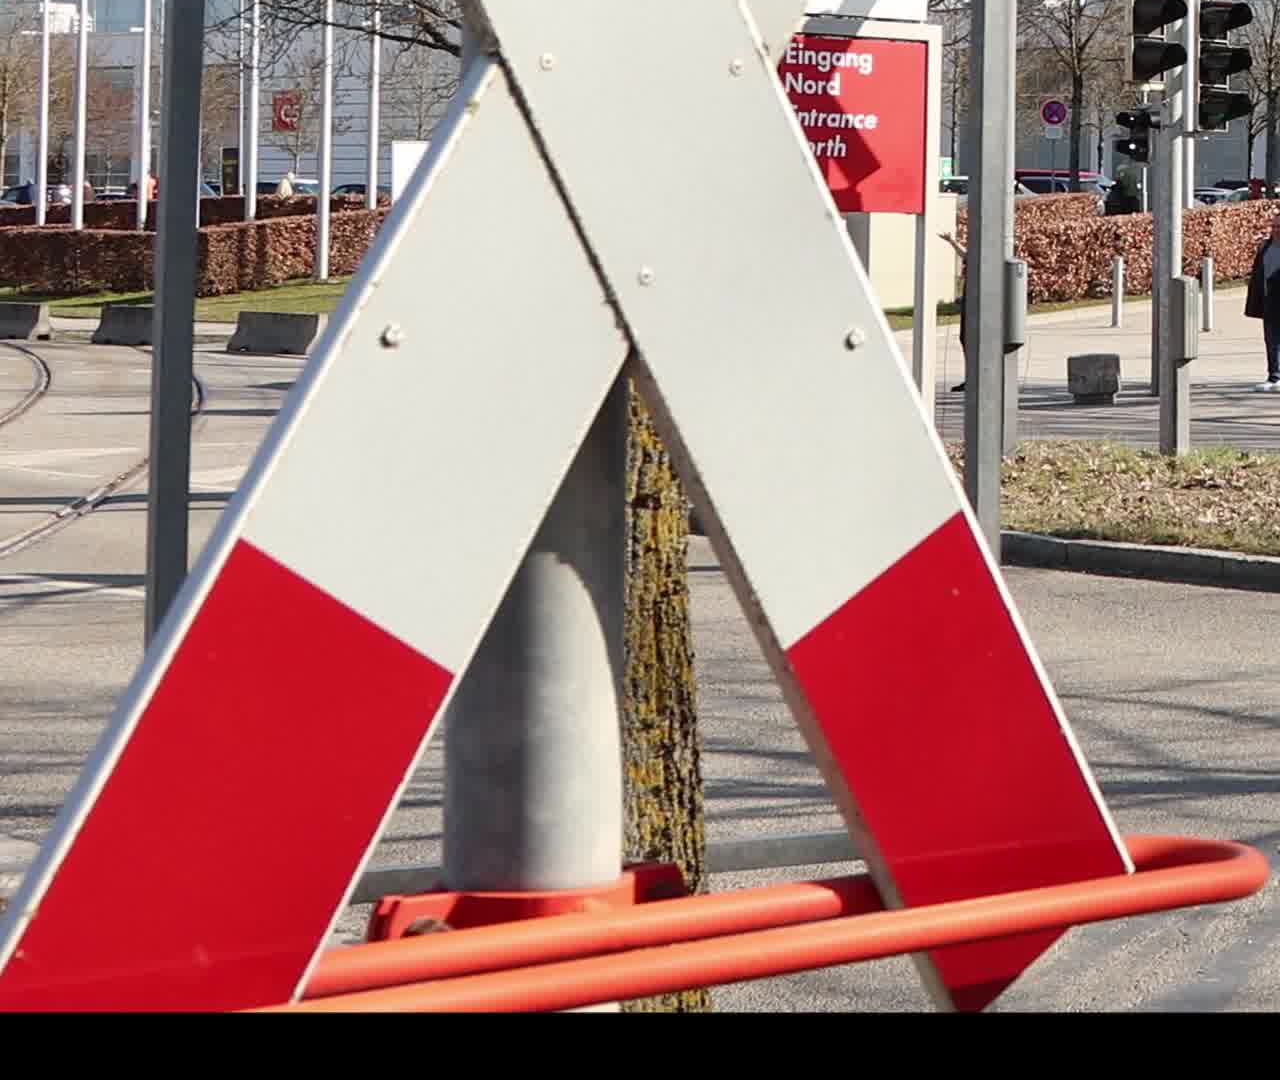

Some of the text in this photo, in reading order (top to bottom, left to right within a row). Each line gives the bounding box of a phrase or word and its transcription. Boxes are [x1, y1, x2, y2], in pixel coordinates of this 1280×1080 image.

[785, 42, 873, 75] Eingang
[785, 72, 841, 96] Nord
[808, 134, 847, 158] orth
